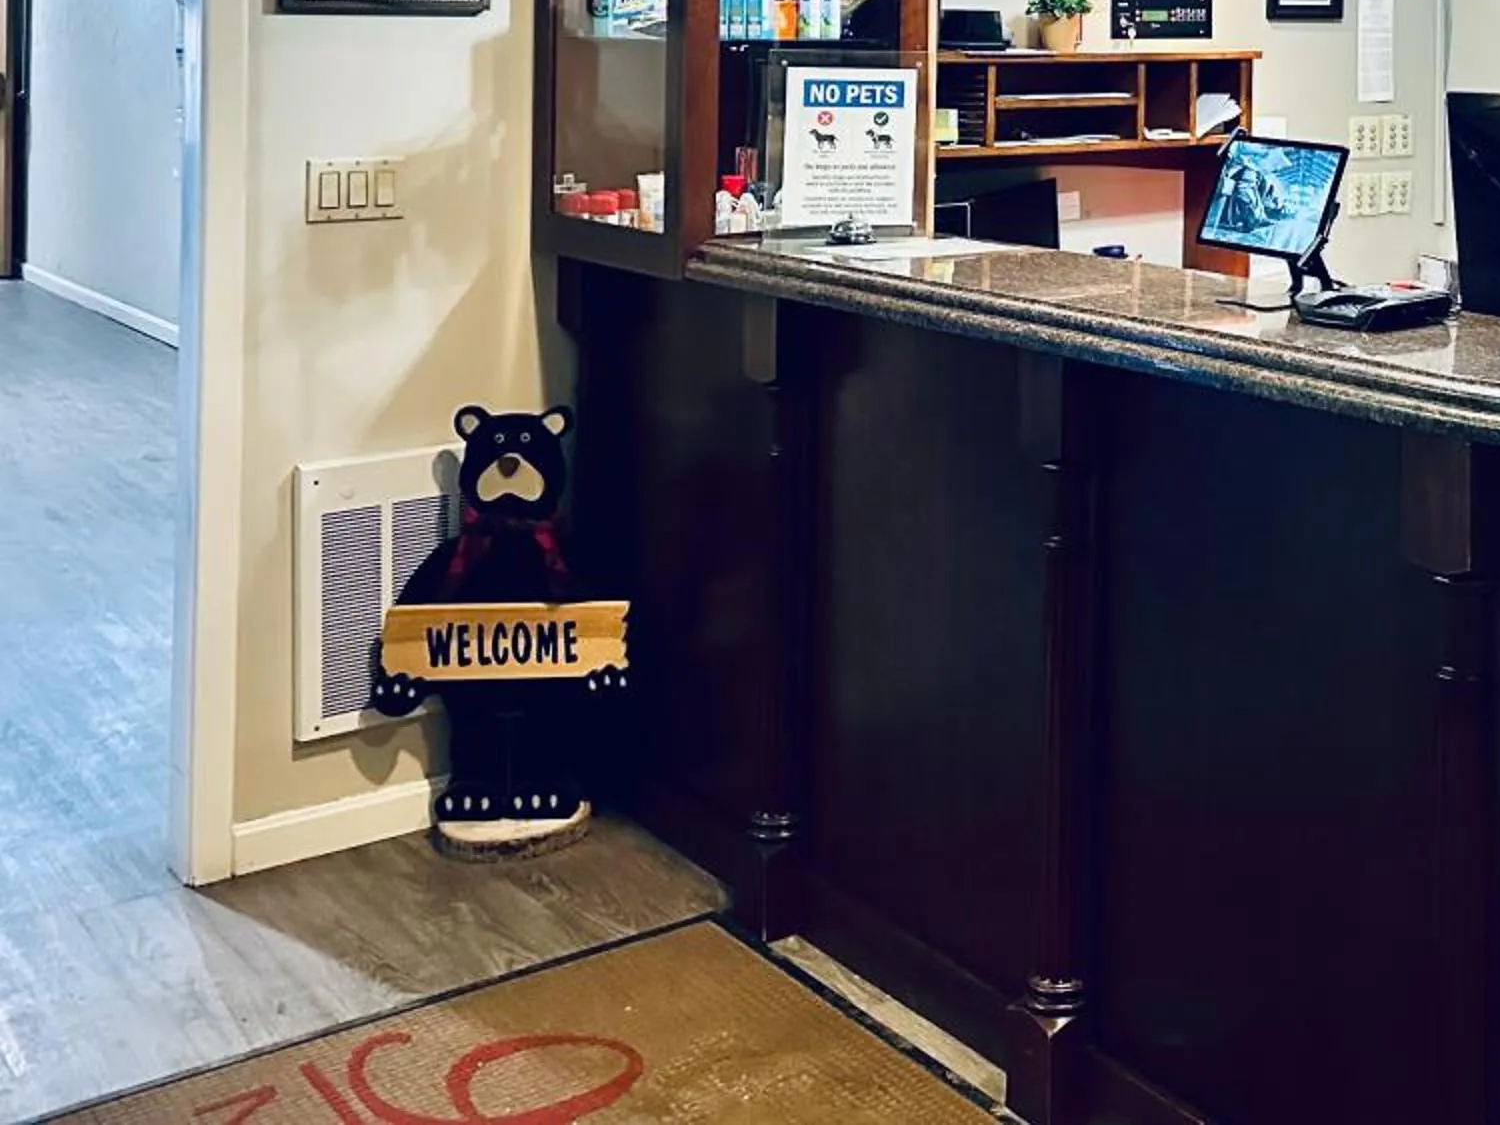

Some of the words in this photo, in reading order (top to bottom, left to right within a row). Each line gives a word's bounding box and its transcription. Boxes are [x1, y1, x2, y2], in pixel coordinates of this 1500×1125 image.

[809, 83, 841, 104] NO
[845, 84, 898, 105] PETS
[427, 622, 577, 667] WELCOME
